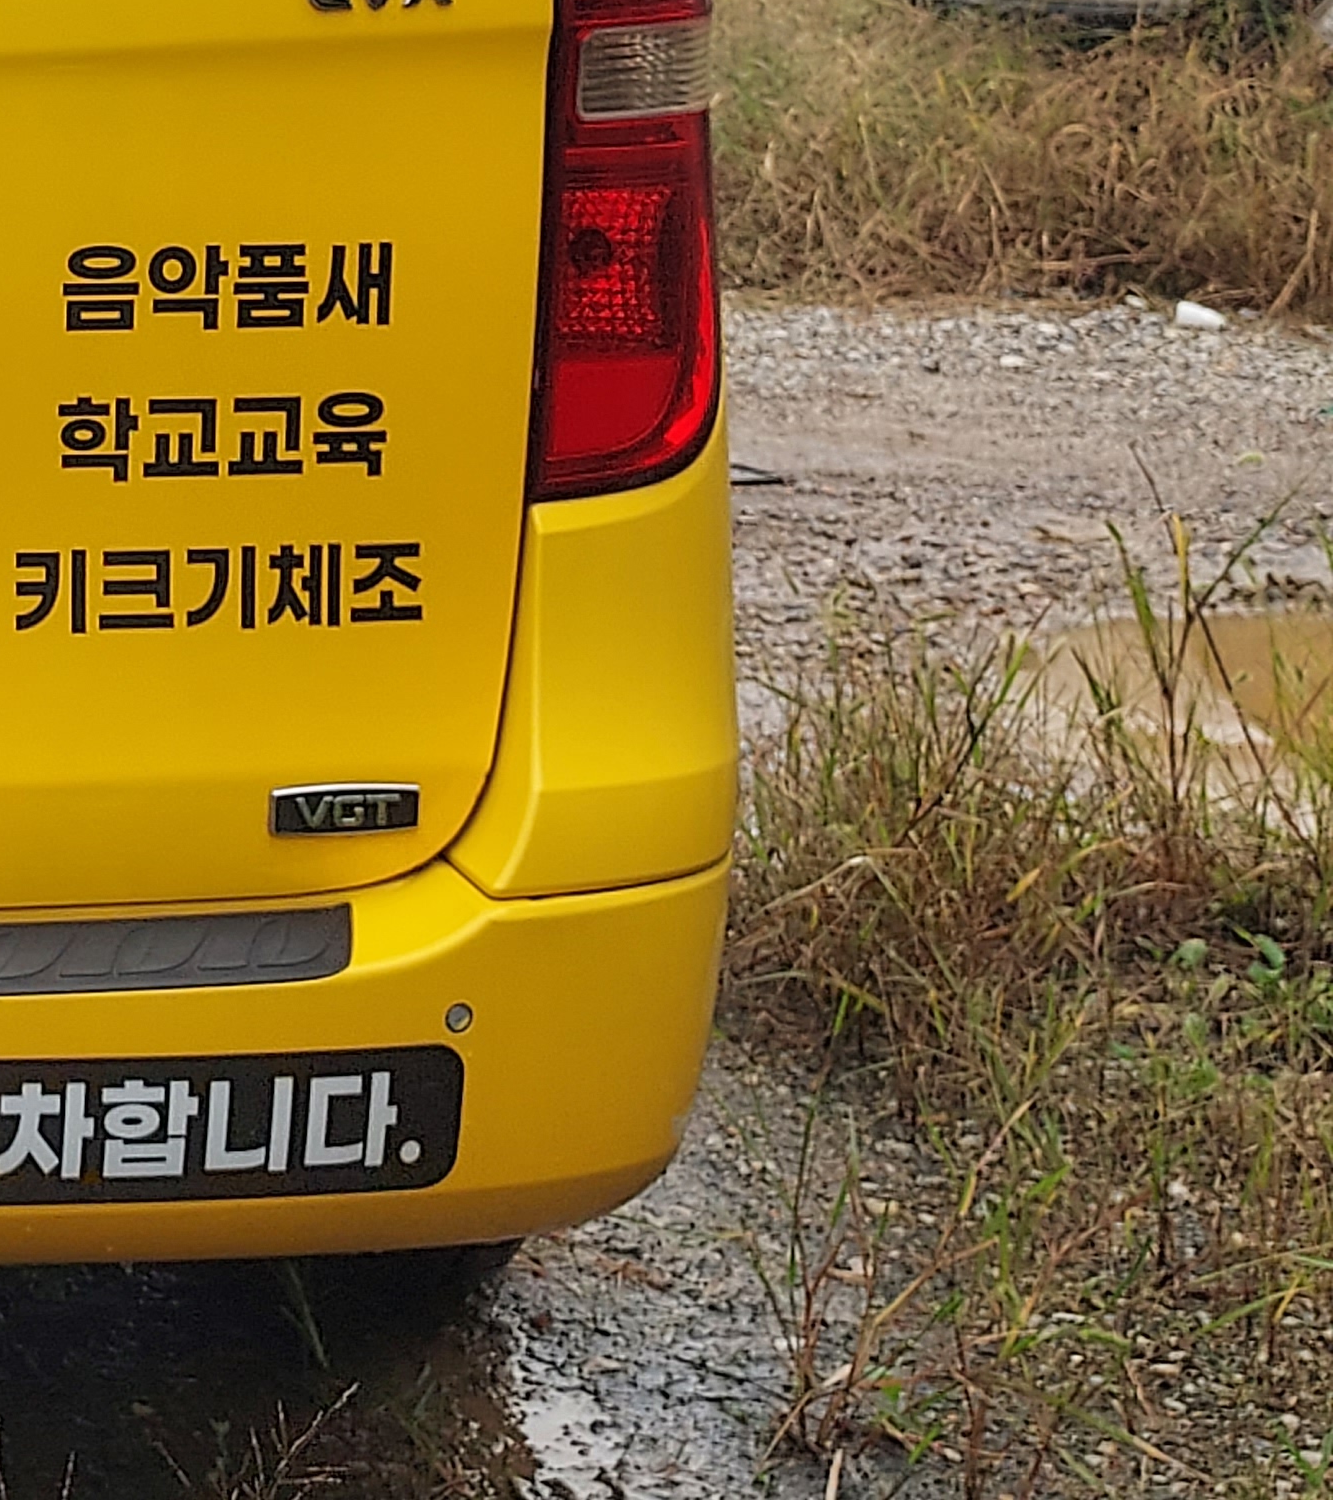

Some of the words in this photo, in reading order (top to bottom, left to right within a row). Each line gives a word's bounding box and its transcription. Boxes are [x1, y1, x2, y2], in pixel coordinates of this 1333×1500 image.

[62, 242, 393, 330] 음악품새
[58, 392, 387, 482] 학교교육
[15, 543, 423, 634] 키크기체조
[296, 794, 401, 828] VGT
